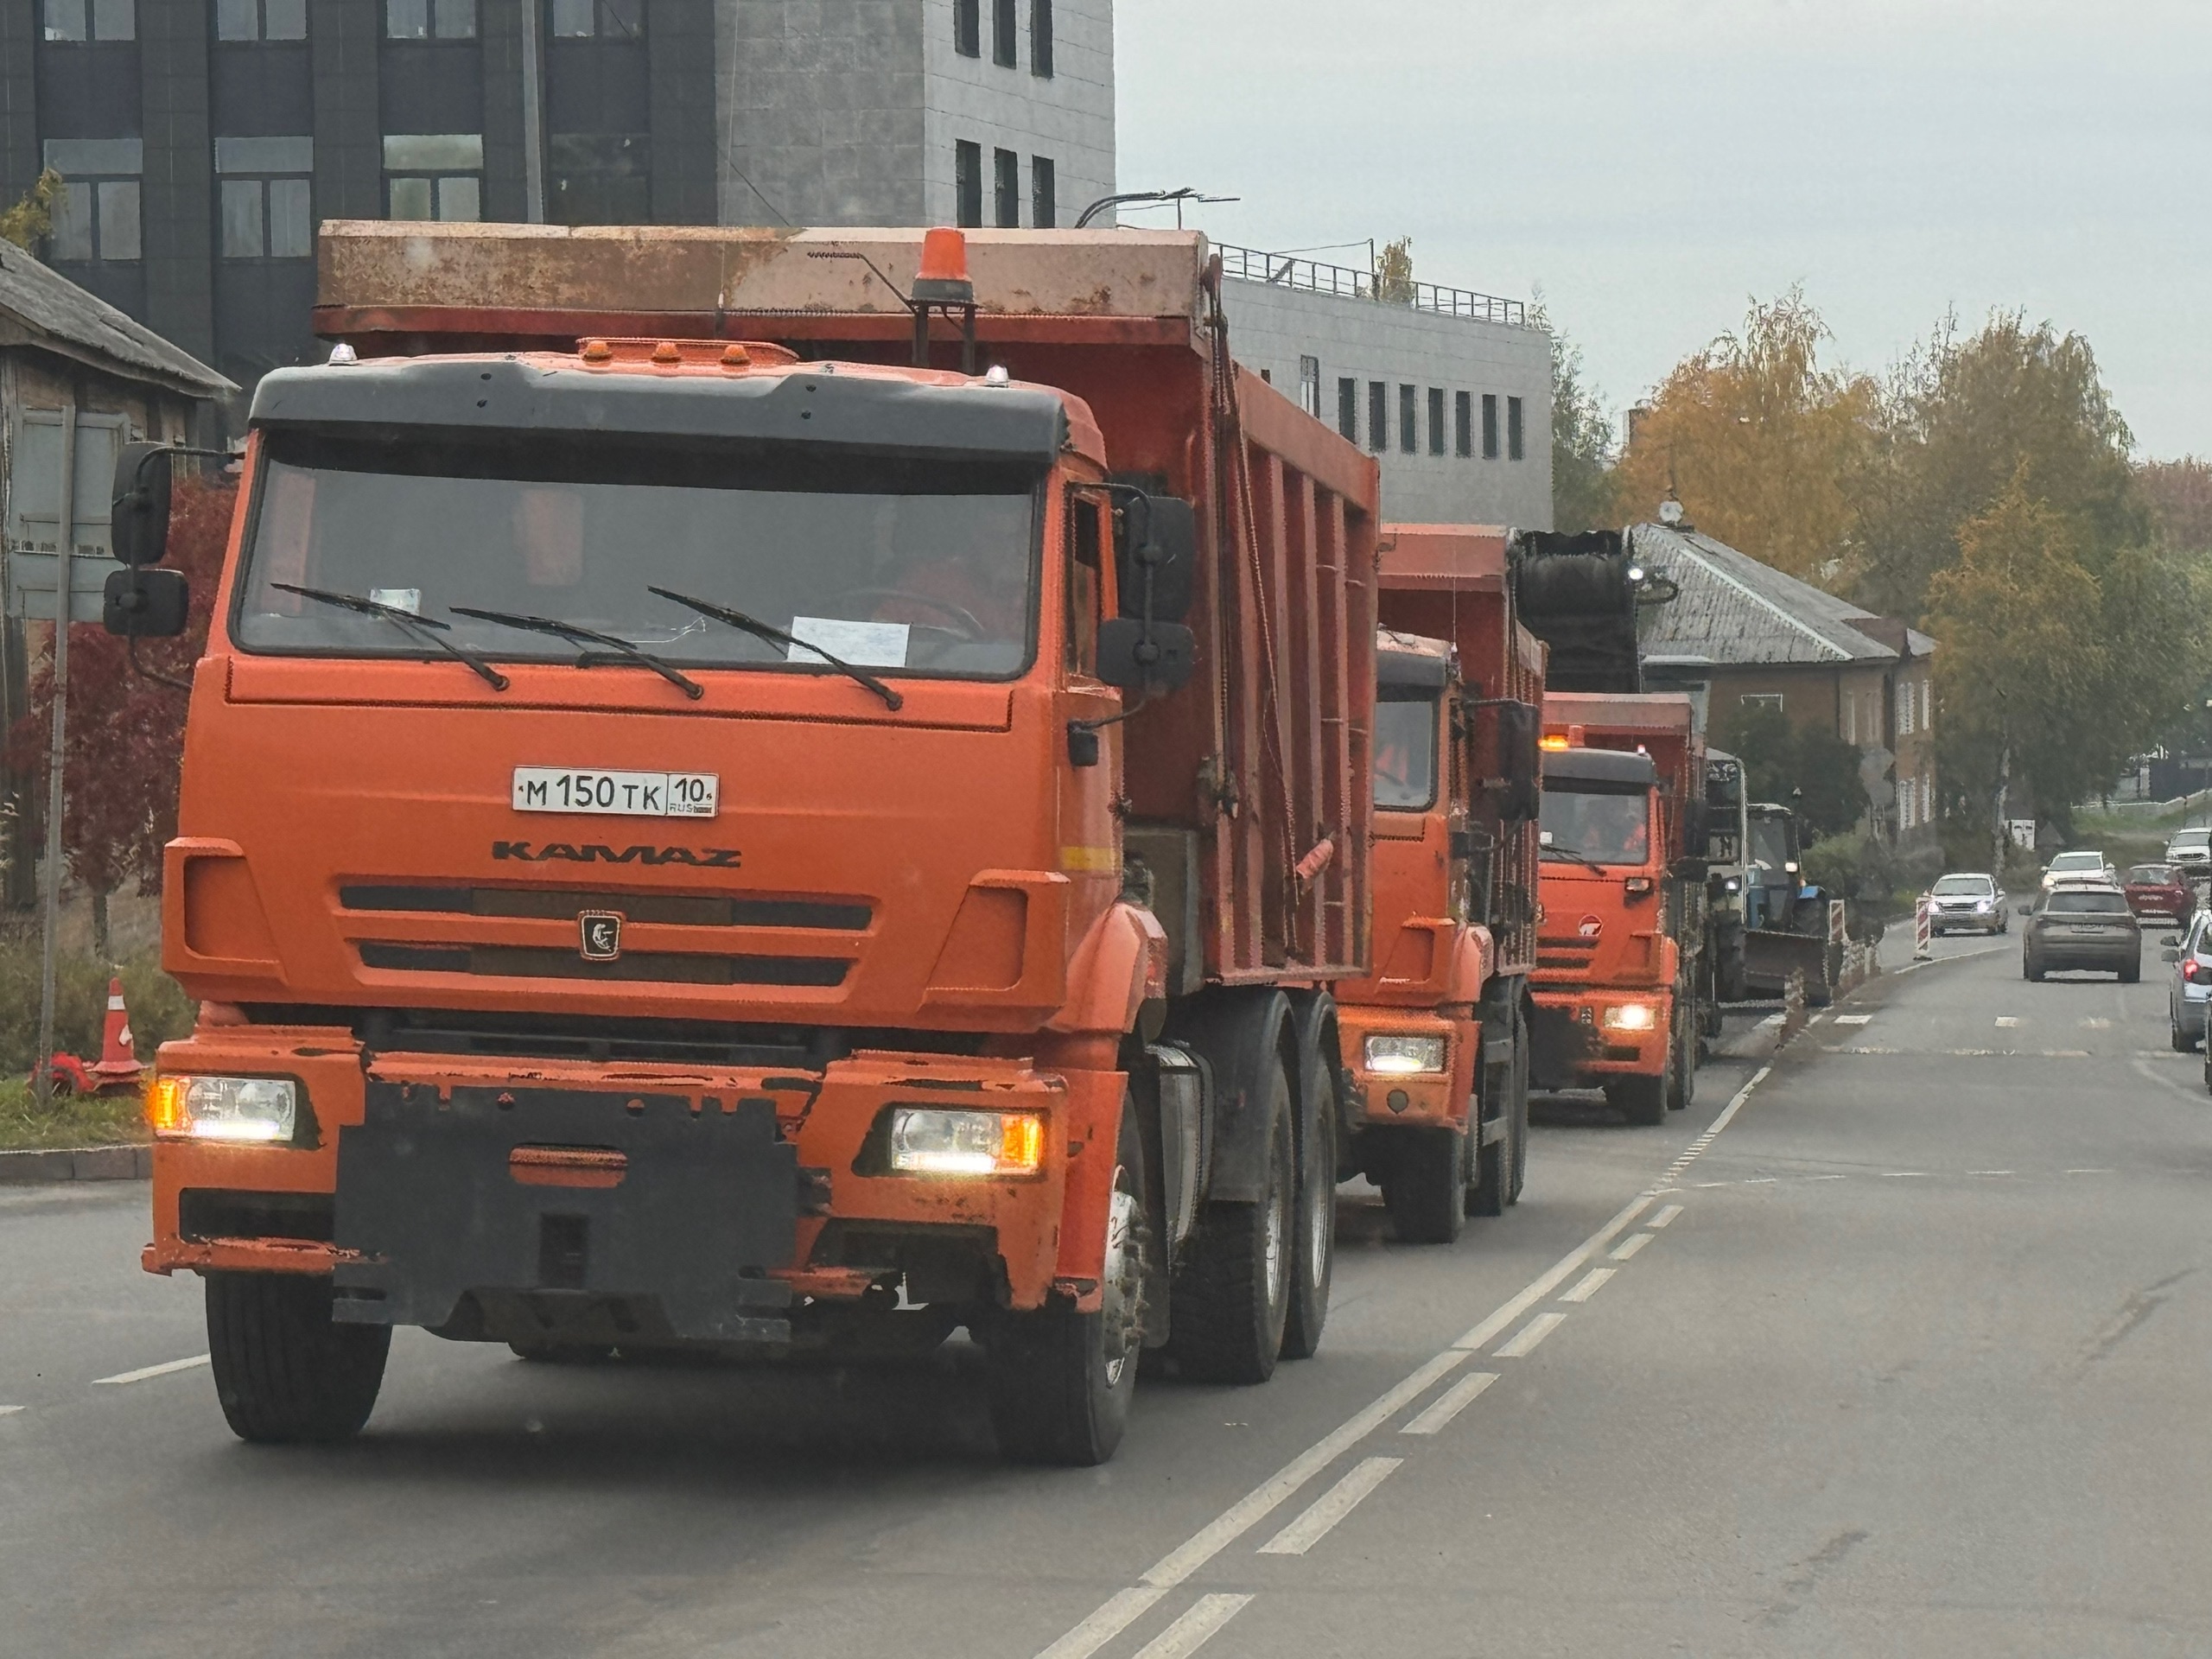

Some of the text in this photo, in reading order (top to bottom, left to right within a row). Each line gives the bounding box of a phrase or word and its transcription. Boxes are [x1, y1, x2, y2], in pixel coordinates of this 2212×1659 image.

[674, 778, 705, 803] 10
[669, 803, 693, 813] RUS
[492, 841, 742, 868] KAMAZ
